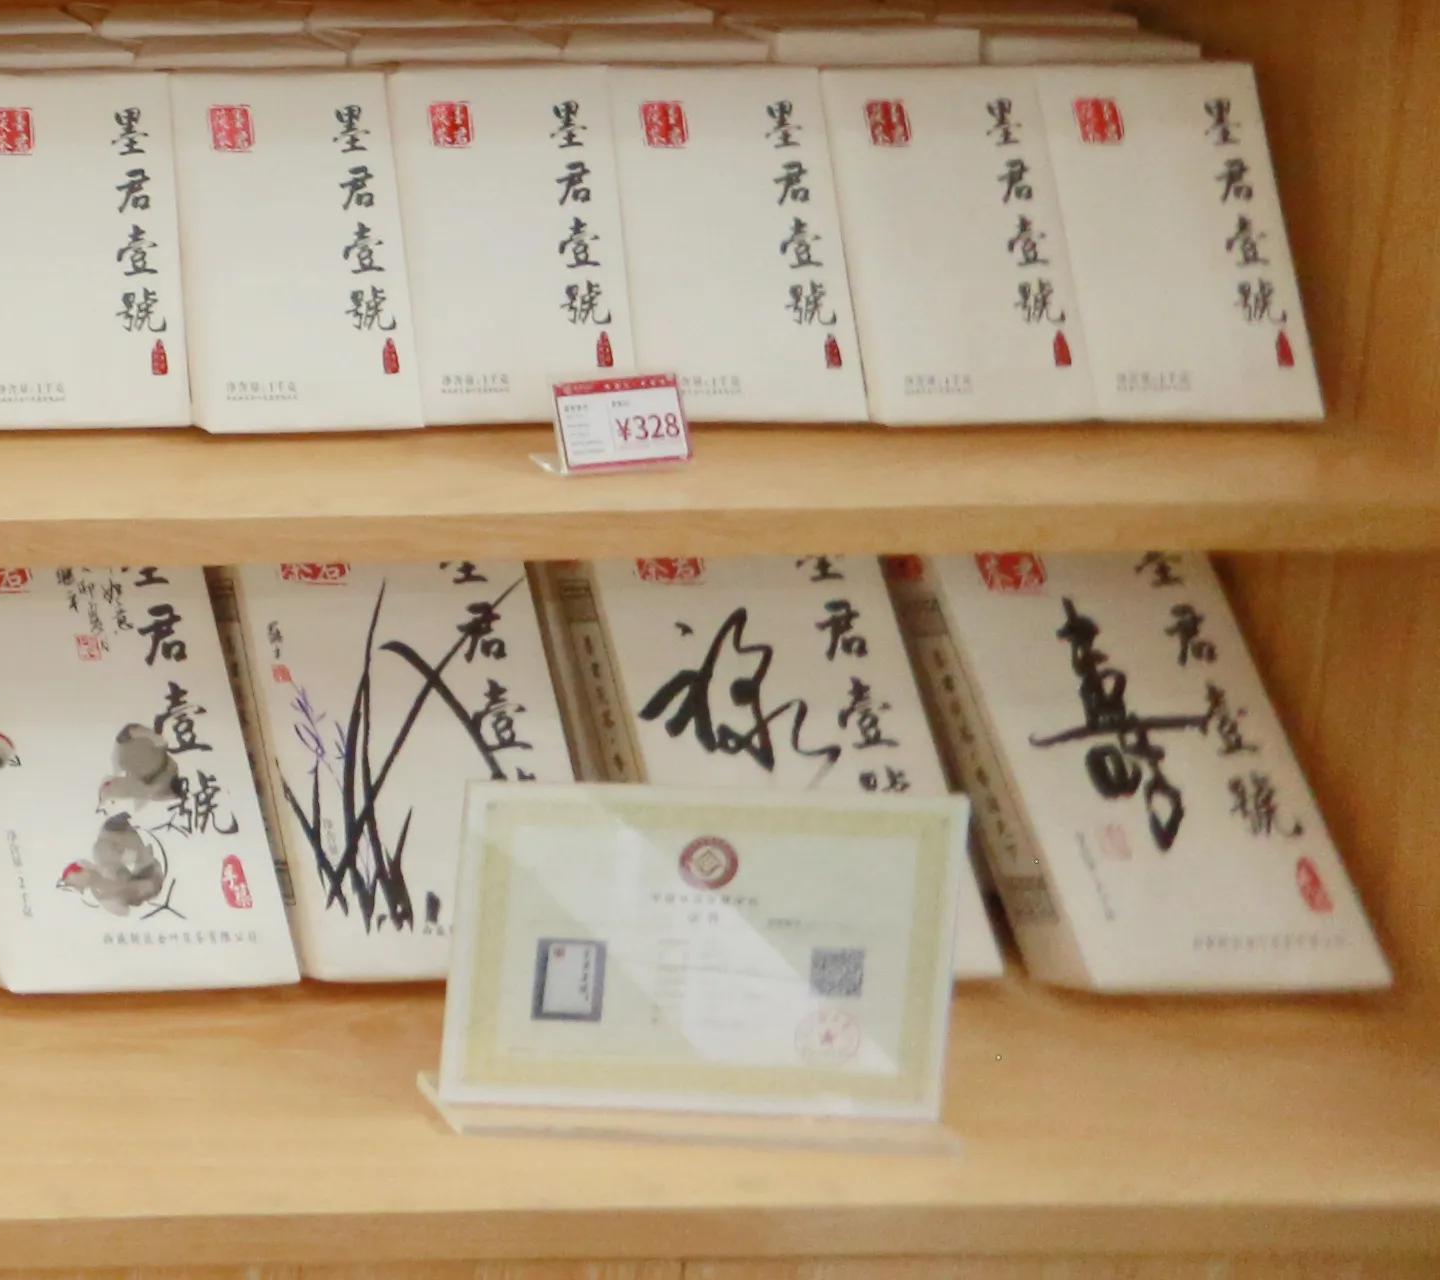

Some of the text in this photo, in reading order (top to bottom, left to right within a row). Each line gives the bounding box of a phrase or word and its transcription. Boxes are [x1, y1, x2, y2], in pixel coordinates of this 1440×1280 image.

[110, 106, 167, 333] 墨君壹號
[332, 103, 397, 332] 墨君壹號
[549, 99, 612, 325] 墨君壹號
[764, 99, 837, 326] 墨君壹號
[986, 99, 1065, 325] 墨君壹號
[1203, 98, 1288, 326] 墨君壹號
[615, 412, 680, 441] ¥328
[134, 566, 240, 835] 君壹號
[440, 561, 535, 781] 君壹
